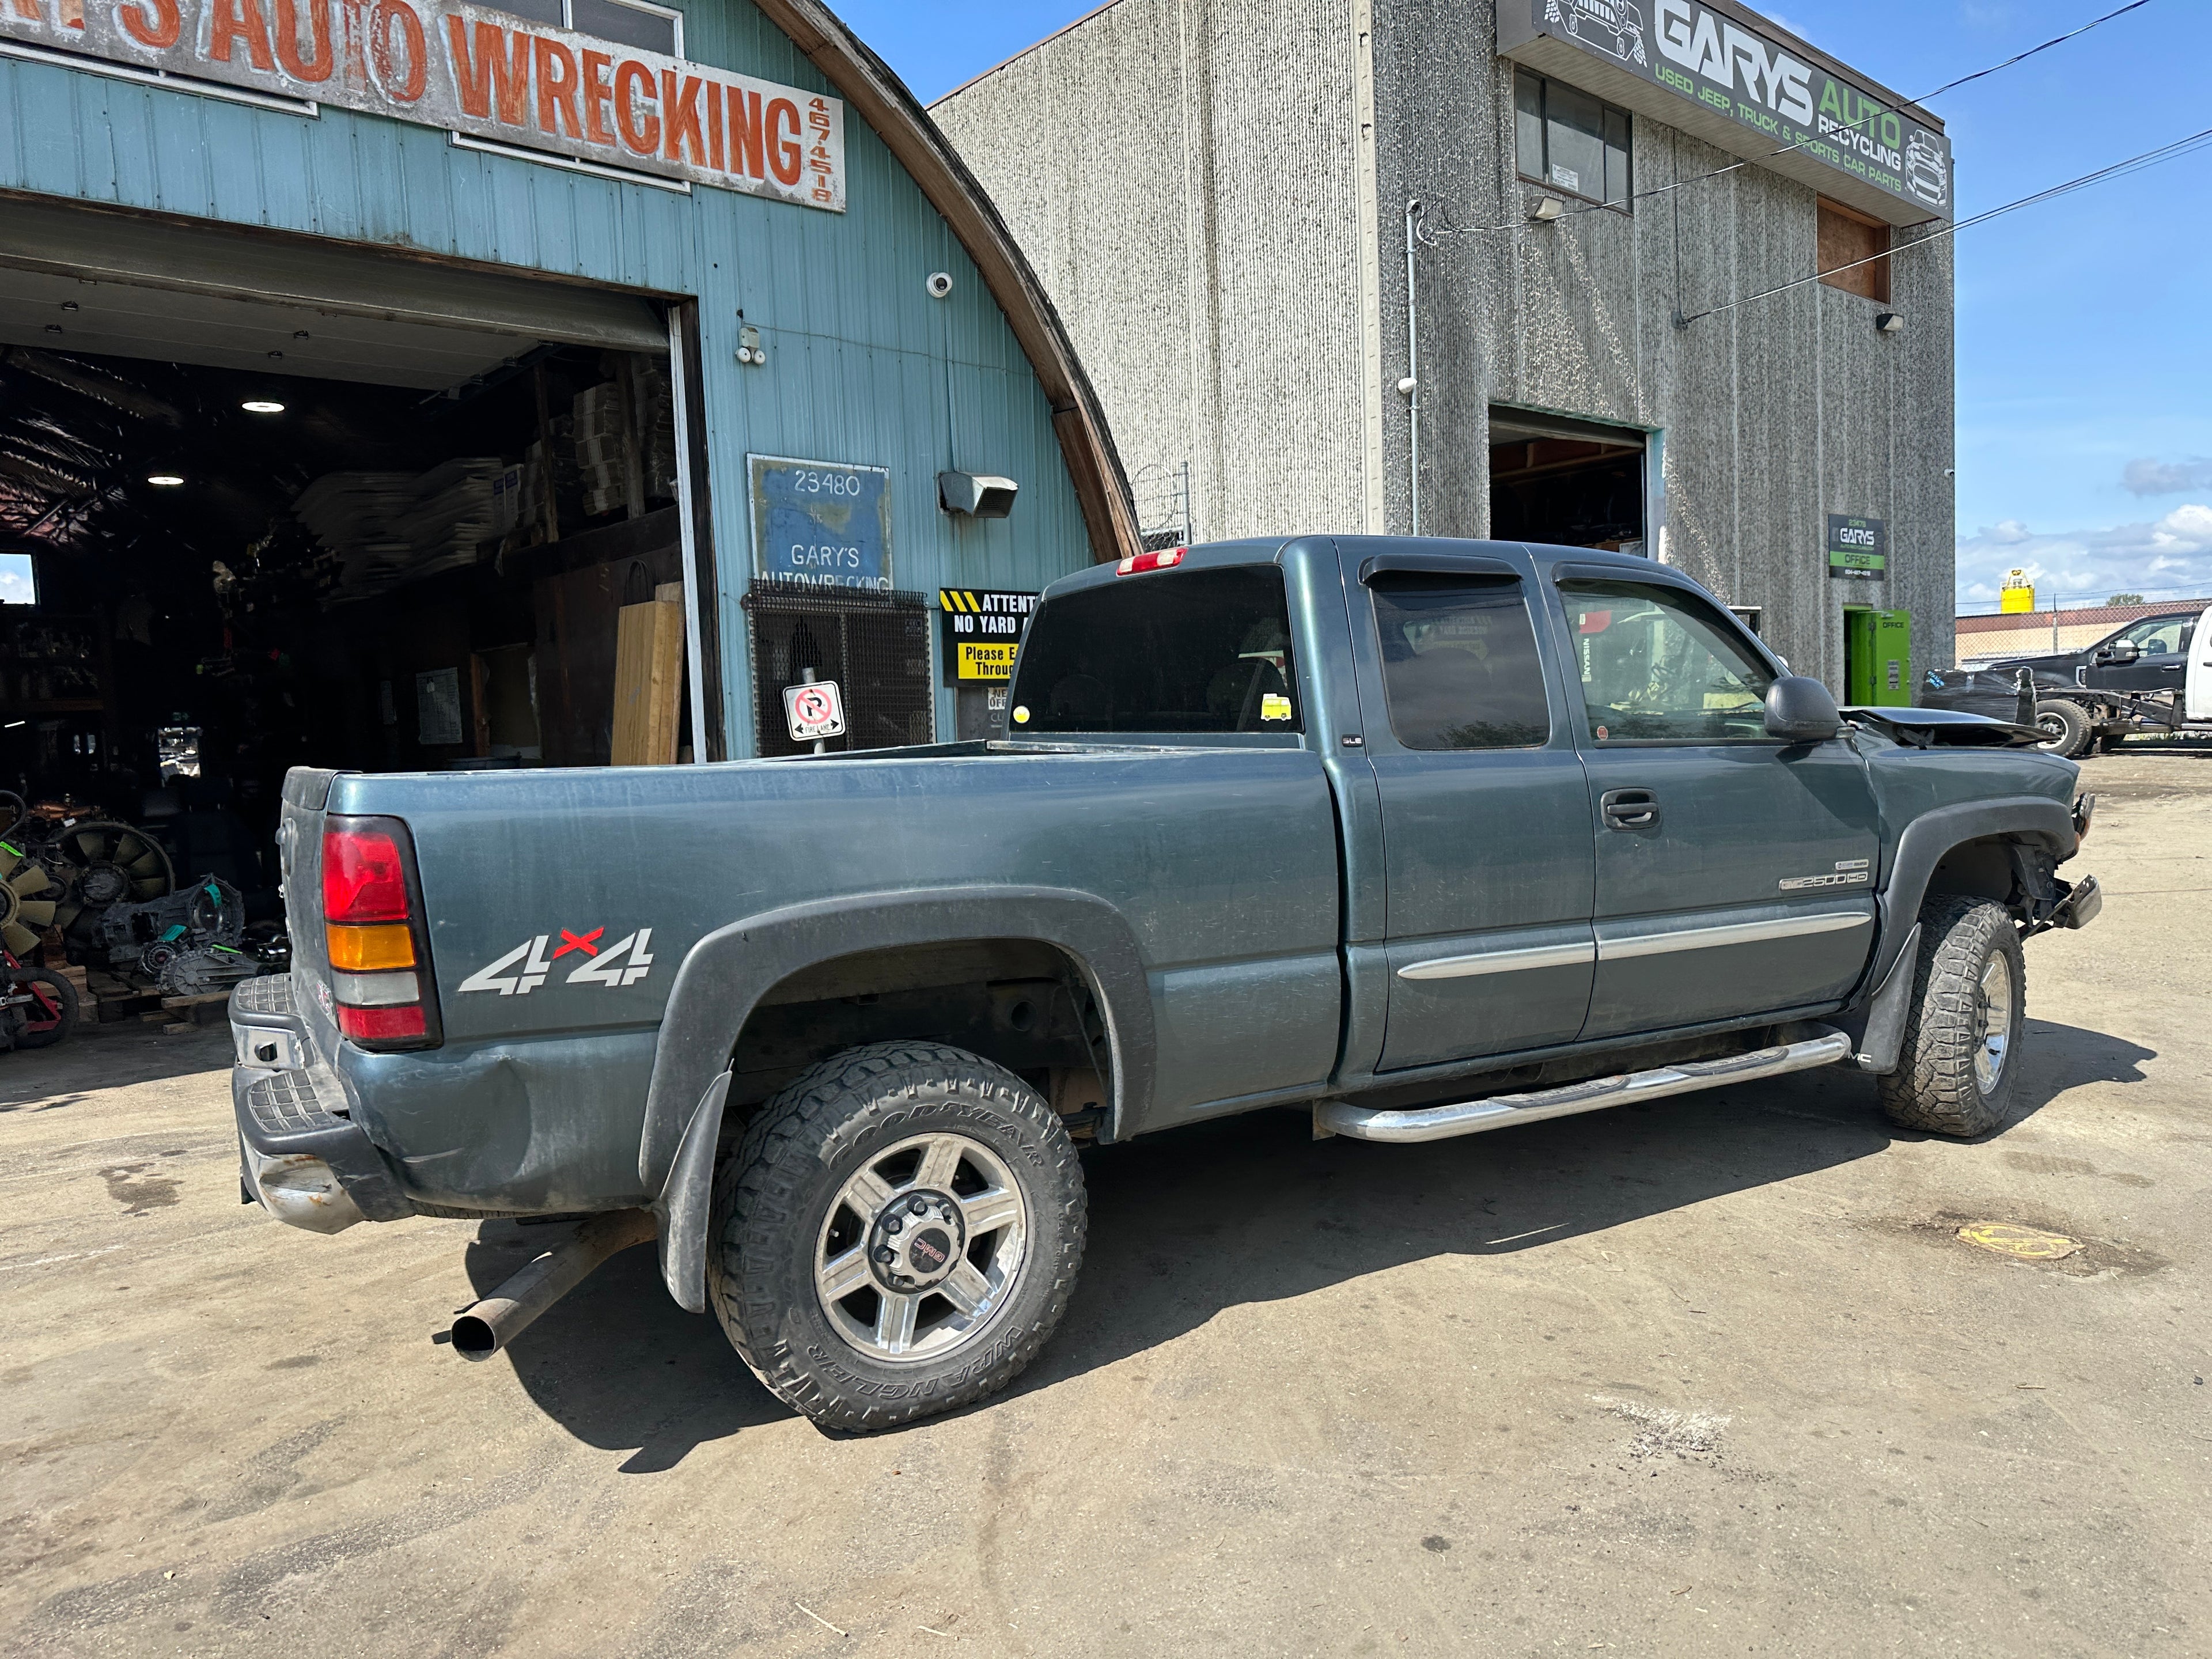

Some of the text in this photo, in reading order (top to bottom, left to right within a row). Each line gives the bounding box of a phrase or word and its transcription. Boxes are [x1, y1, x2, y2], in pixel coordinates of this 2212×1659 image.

[1654, 0, 1813, 126] GARYS
[446, 14, 802, 186] WRECKING
[1655, 63, 1902, 192] USED JEEP, TRUCK & SPORTS CAR PARTS
[1819, 79, 1900, 150] AUTO
[1818, 113, 1901, 171] RECYCLING
[794, 469, 860, 496] 23480
[1840, 528, 1875, 546] GARYS
[791, 544, 859, 568] GARY'S
[1845, 554, 1870, 565] OFFICE
[982, 594, 1038, 613] ATTENT
[954, 615, 974, 633] NO
[980, 616, 1016, 634] YARD
[965, 646, 1019, 661] Please E
[914, 1237, 945, 1263] GMC
[806, 1325, 1024, 1400] WRANGLER
